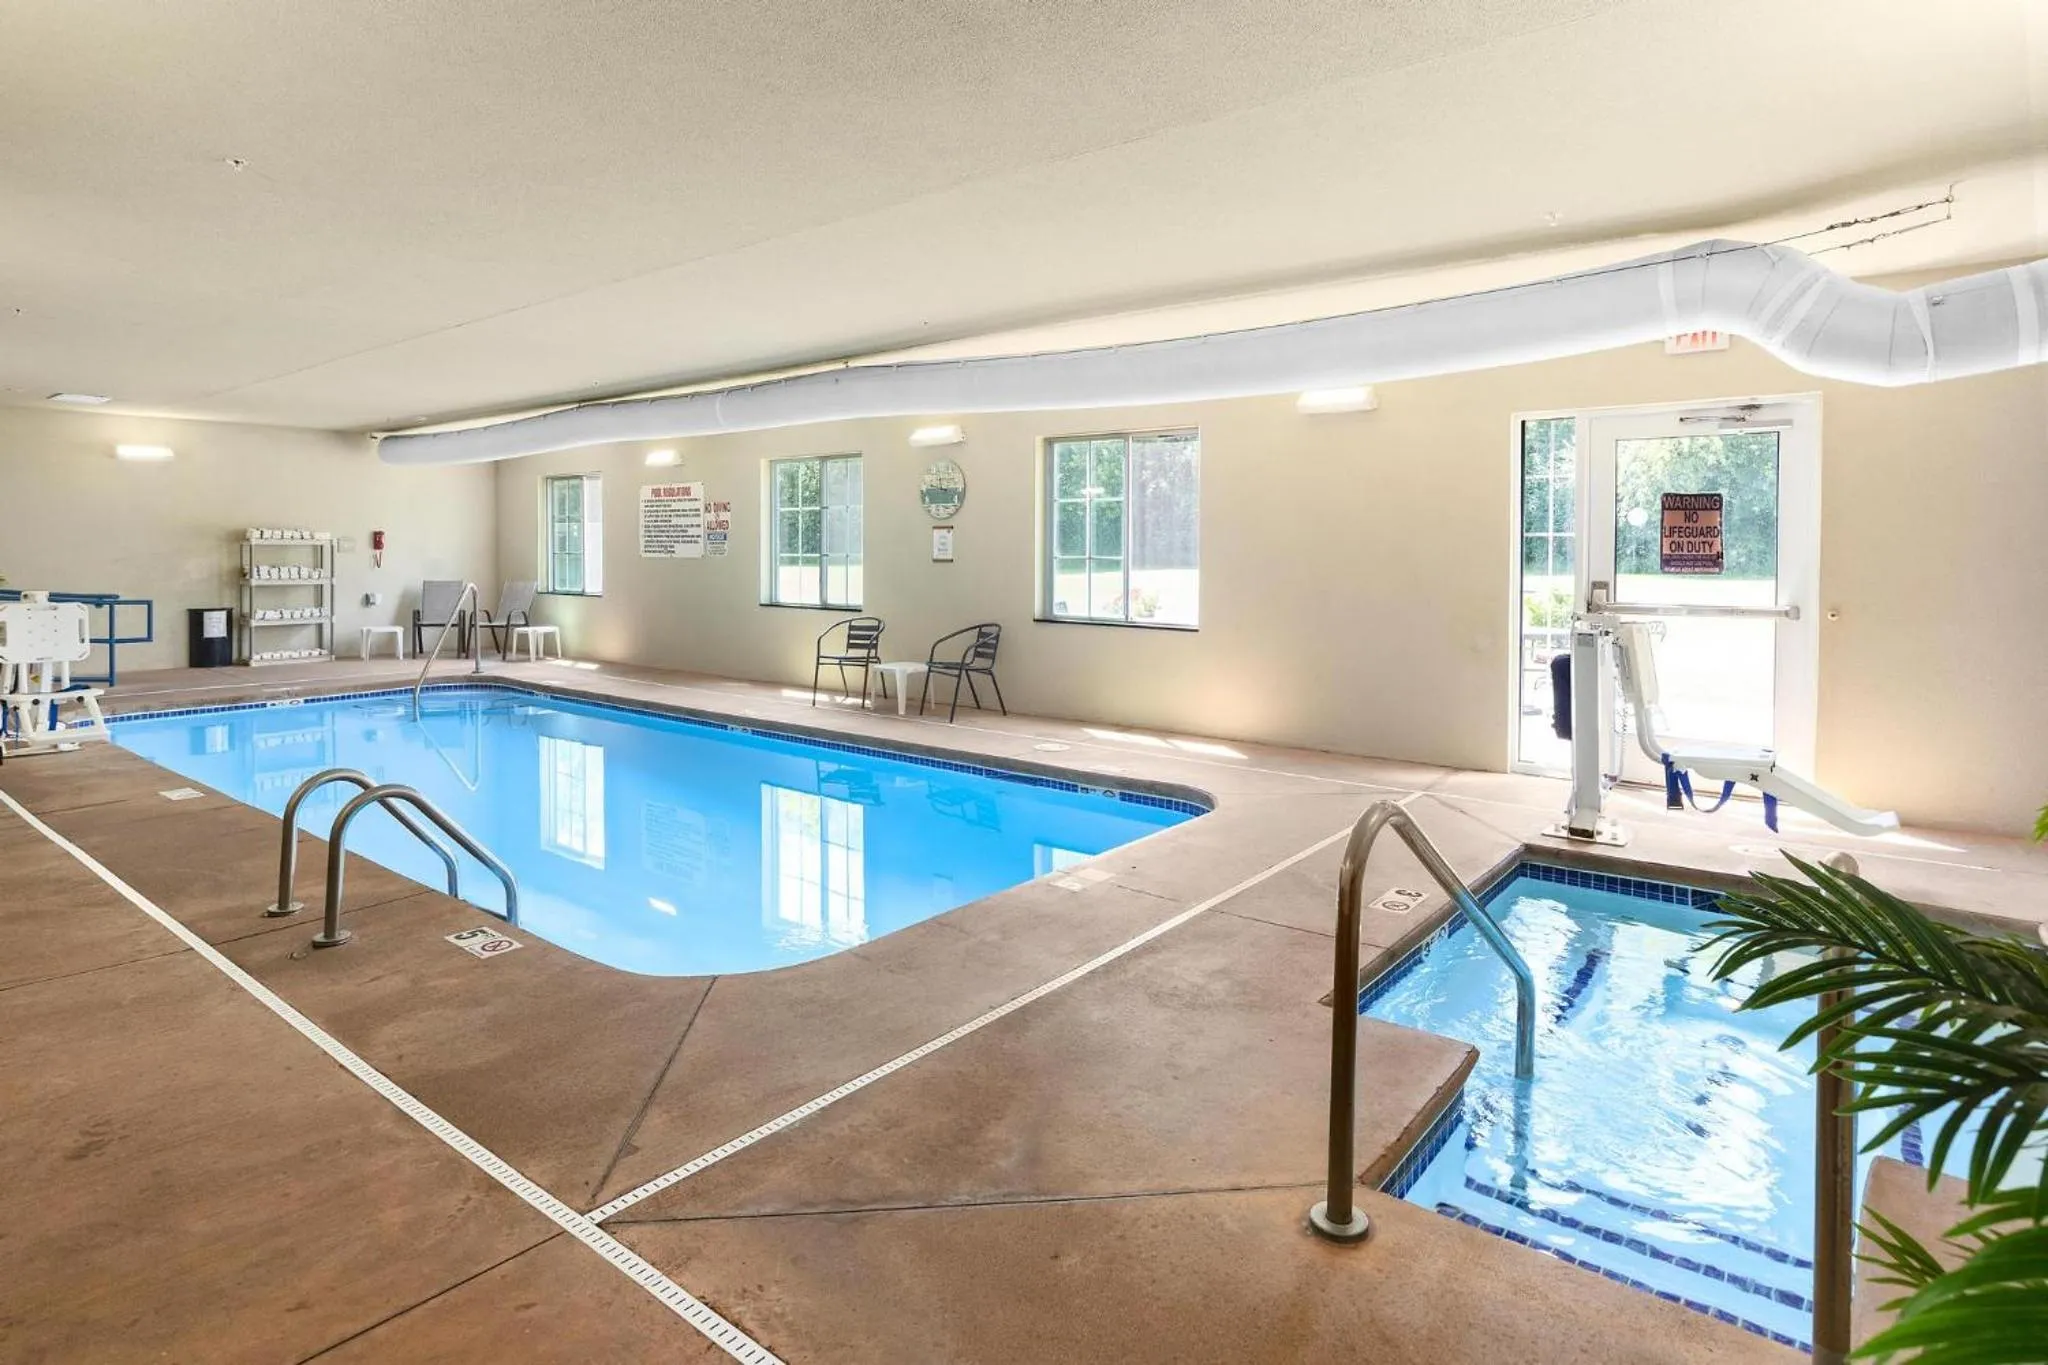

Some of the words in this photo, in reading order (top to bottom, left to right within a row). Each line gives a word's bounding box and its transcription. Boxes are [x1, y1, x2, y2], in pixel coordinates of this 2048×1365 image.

[1663, 496, 1720, 509] WARNING
[1684, 511, 1699, 524] NO
[1664, 526, 1720, 538] LIFEGUARD
[1669, 541, 1684, 553] ON
[1687, 541, 1713, 553] DUTY
